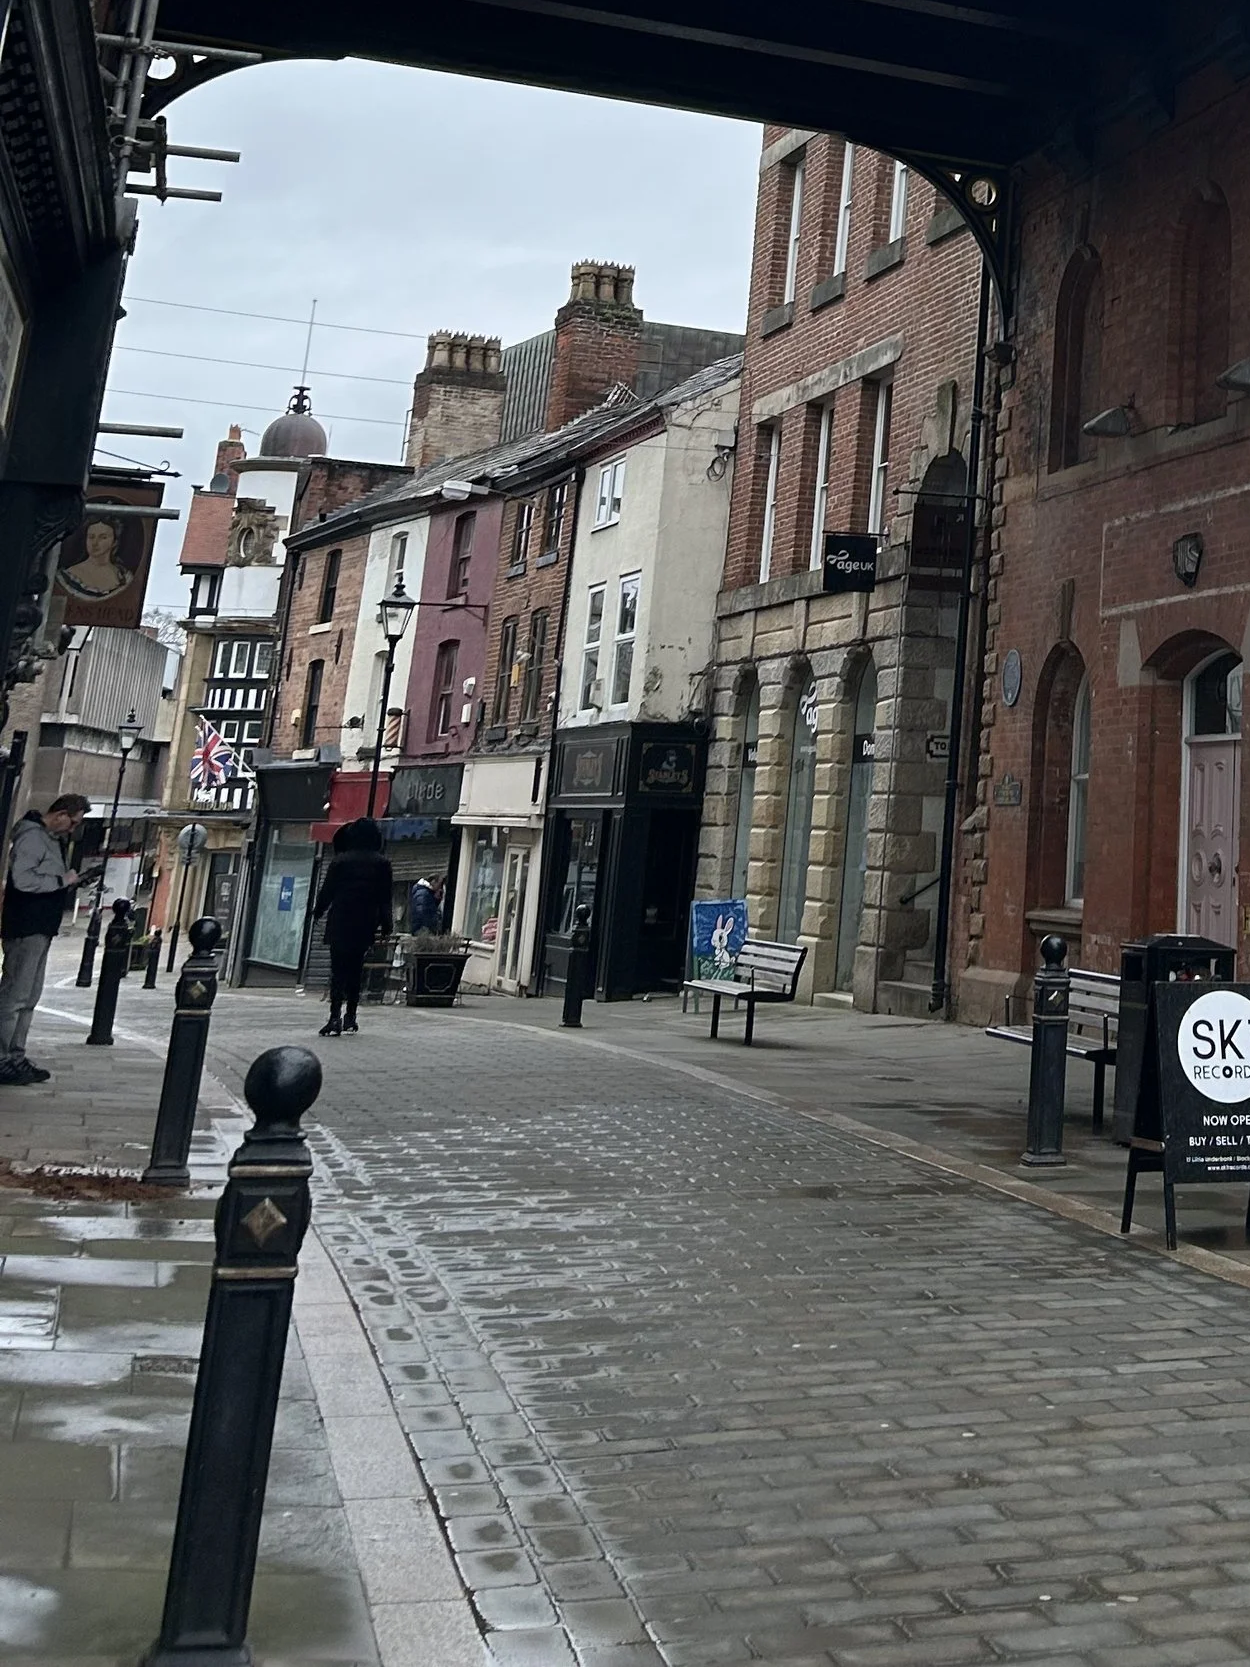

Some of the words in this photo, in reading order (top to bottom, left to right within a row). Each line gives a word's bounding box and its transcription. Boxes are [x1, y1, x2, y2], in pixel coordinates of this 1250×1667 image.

[1203, 1115, 1228, 1126] NOW
[1189, 1136, 1207, 1147] BUY
[1215, 1136, 1238, 1146] SELL
